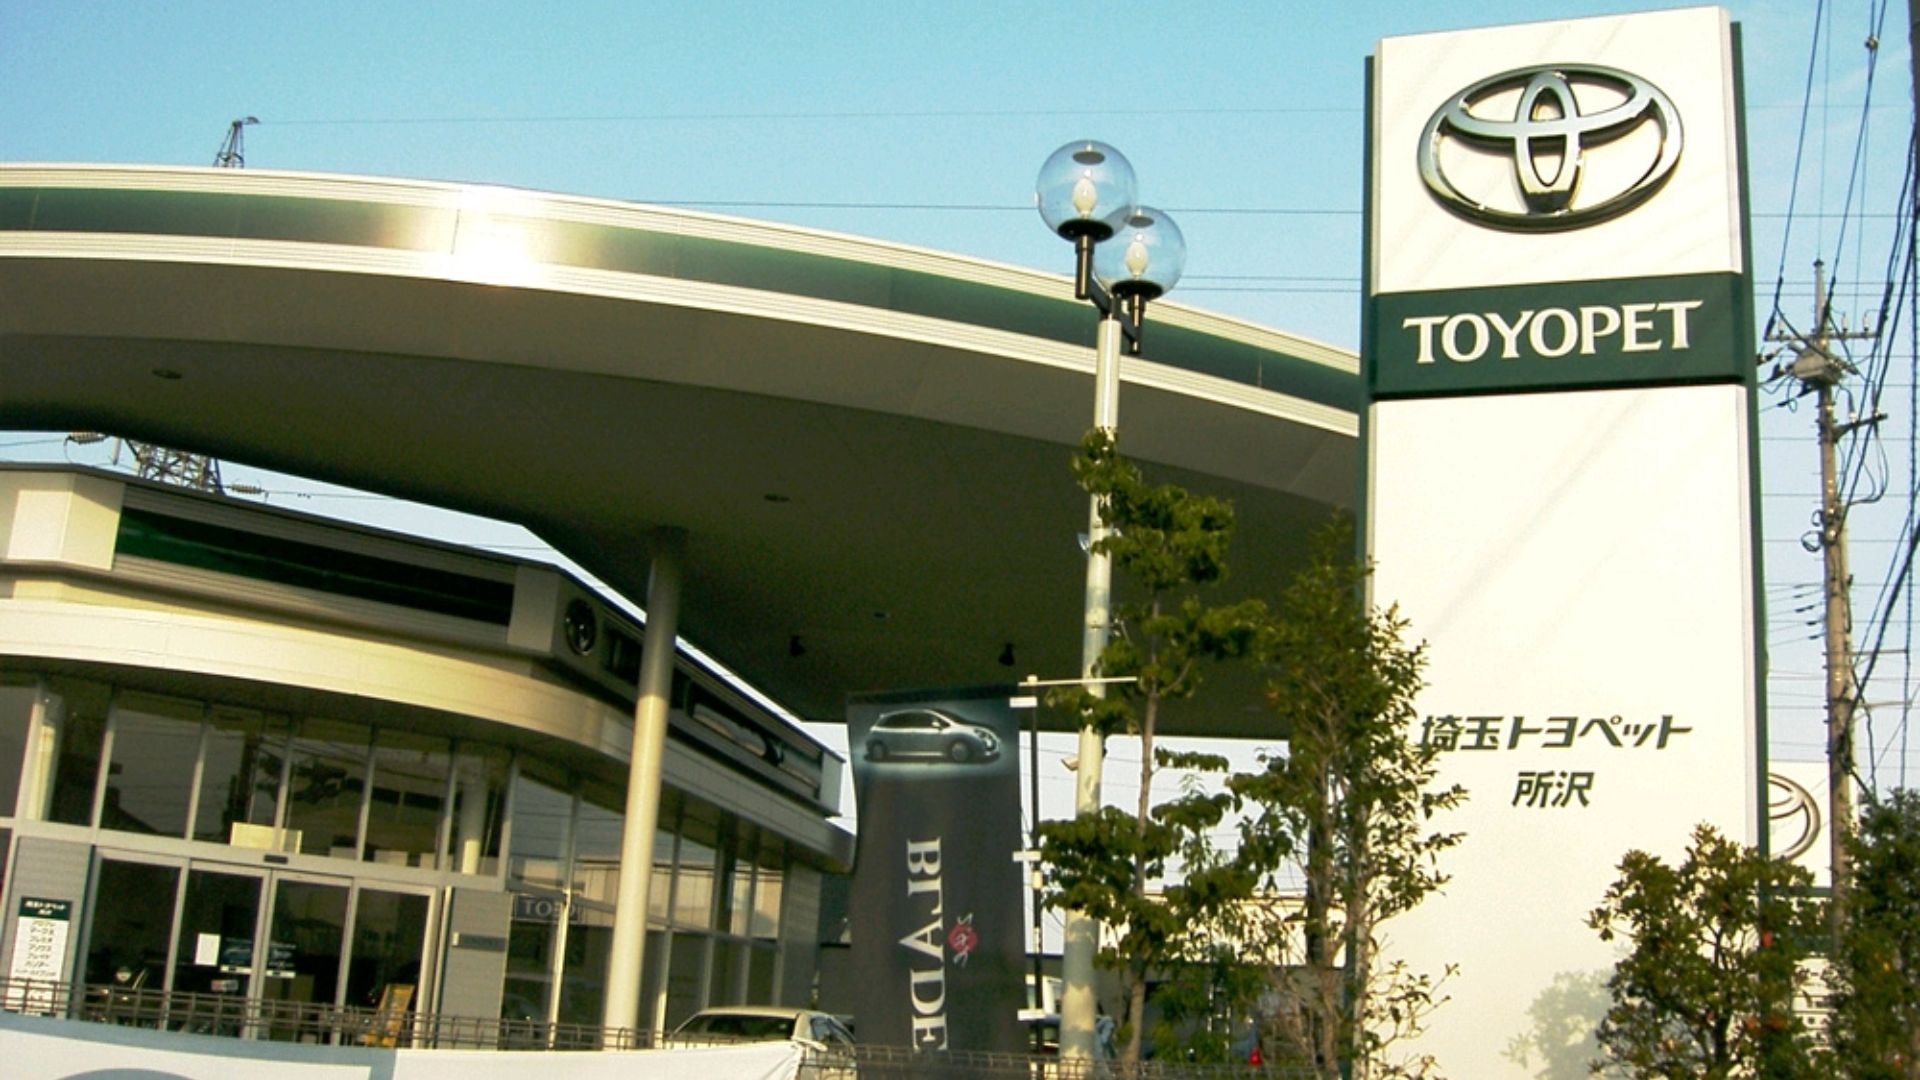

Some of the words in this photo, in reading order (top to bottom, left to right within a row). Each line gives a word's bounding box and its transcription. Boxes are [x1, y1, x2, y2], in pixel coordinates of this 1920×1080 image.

[1402, 299, 1704, 364] TOYOPET
[1420, 714, 1693, 751] 埼玉トヨペット
[1511, 771, 1595, 808] 所沢
